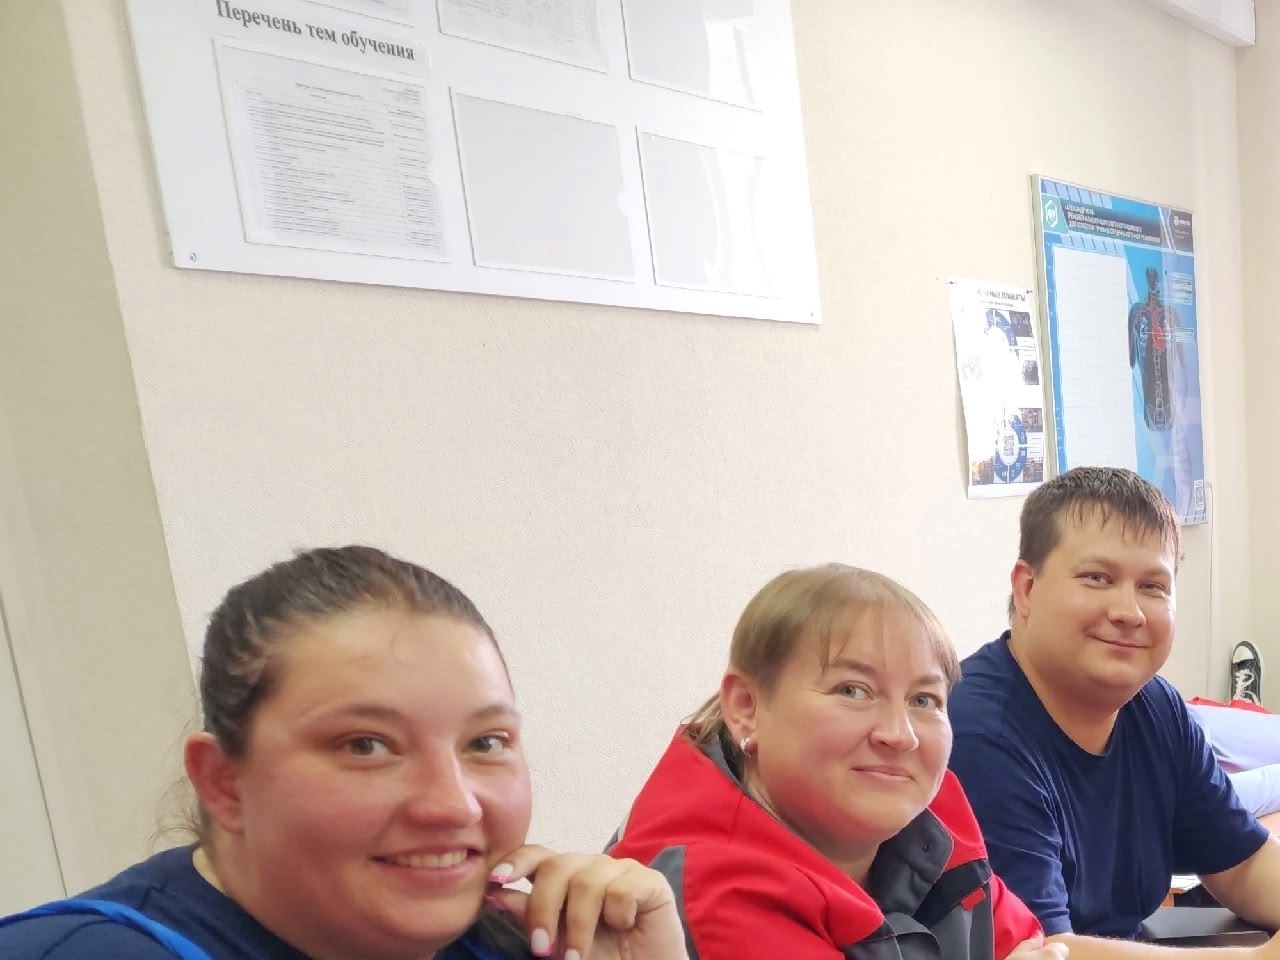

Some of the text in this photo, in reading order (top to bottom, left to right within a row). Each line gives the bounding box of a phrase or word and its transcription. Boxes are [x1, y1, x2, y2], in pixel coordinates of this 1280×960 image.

[215, 0, 416, 61] Перечень тем обучения
